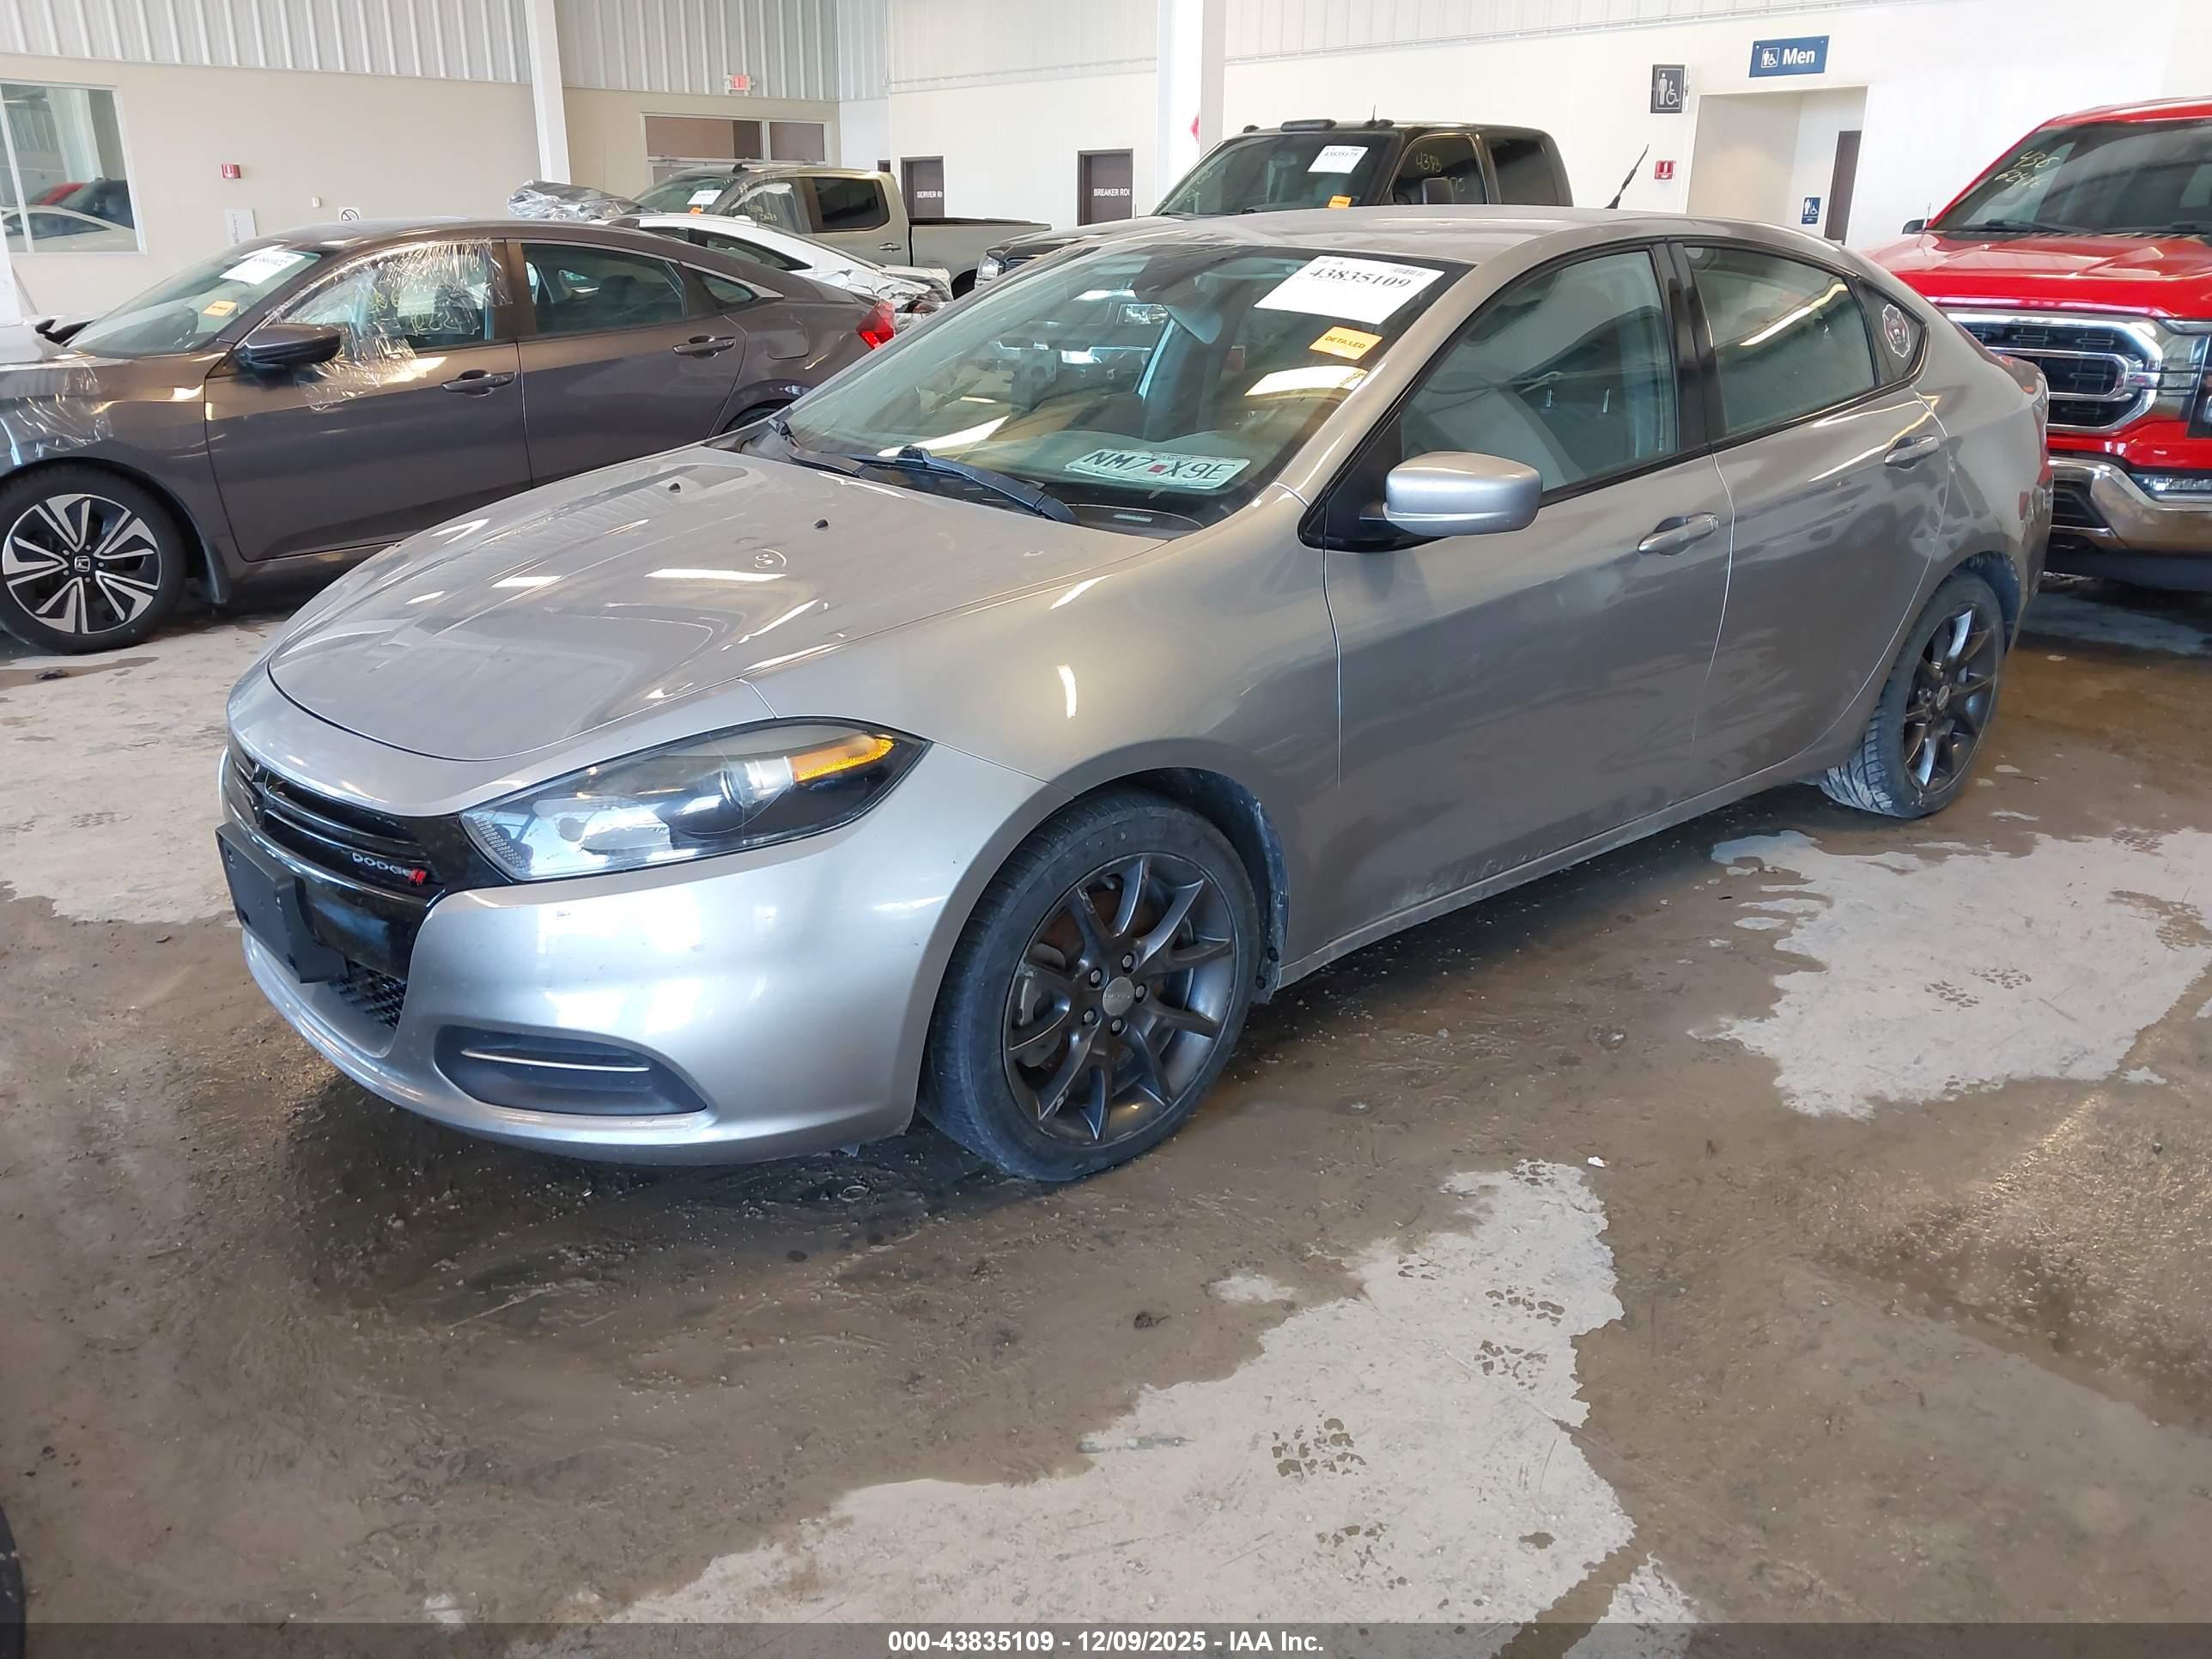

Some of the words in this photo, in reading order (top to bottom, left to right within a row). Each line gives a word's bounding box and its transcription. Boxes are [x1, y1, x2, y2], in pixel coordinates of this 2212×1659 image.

[1782, 48, 1816, 65] Men
[1093, 188, 1120, 197] BREAKER
[1310, 267, 1412, 289] 43835109
[351, 851, 413, 878] DODGE
